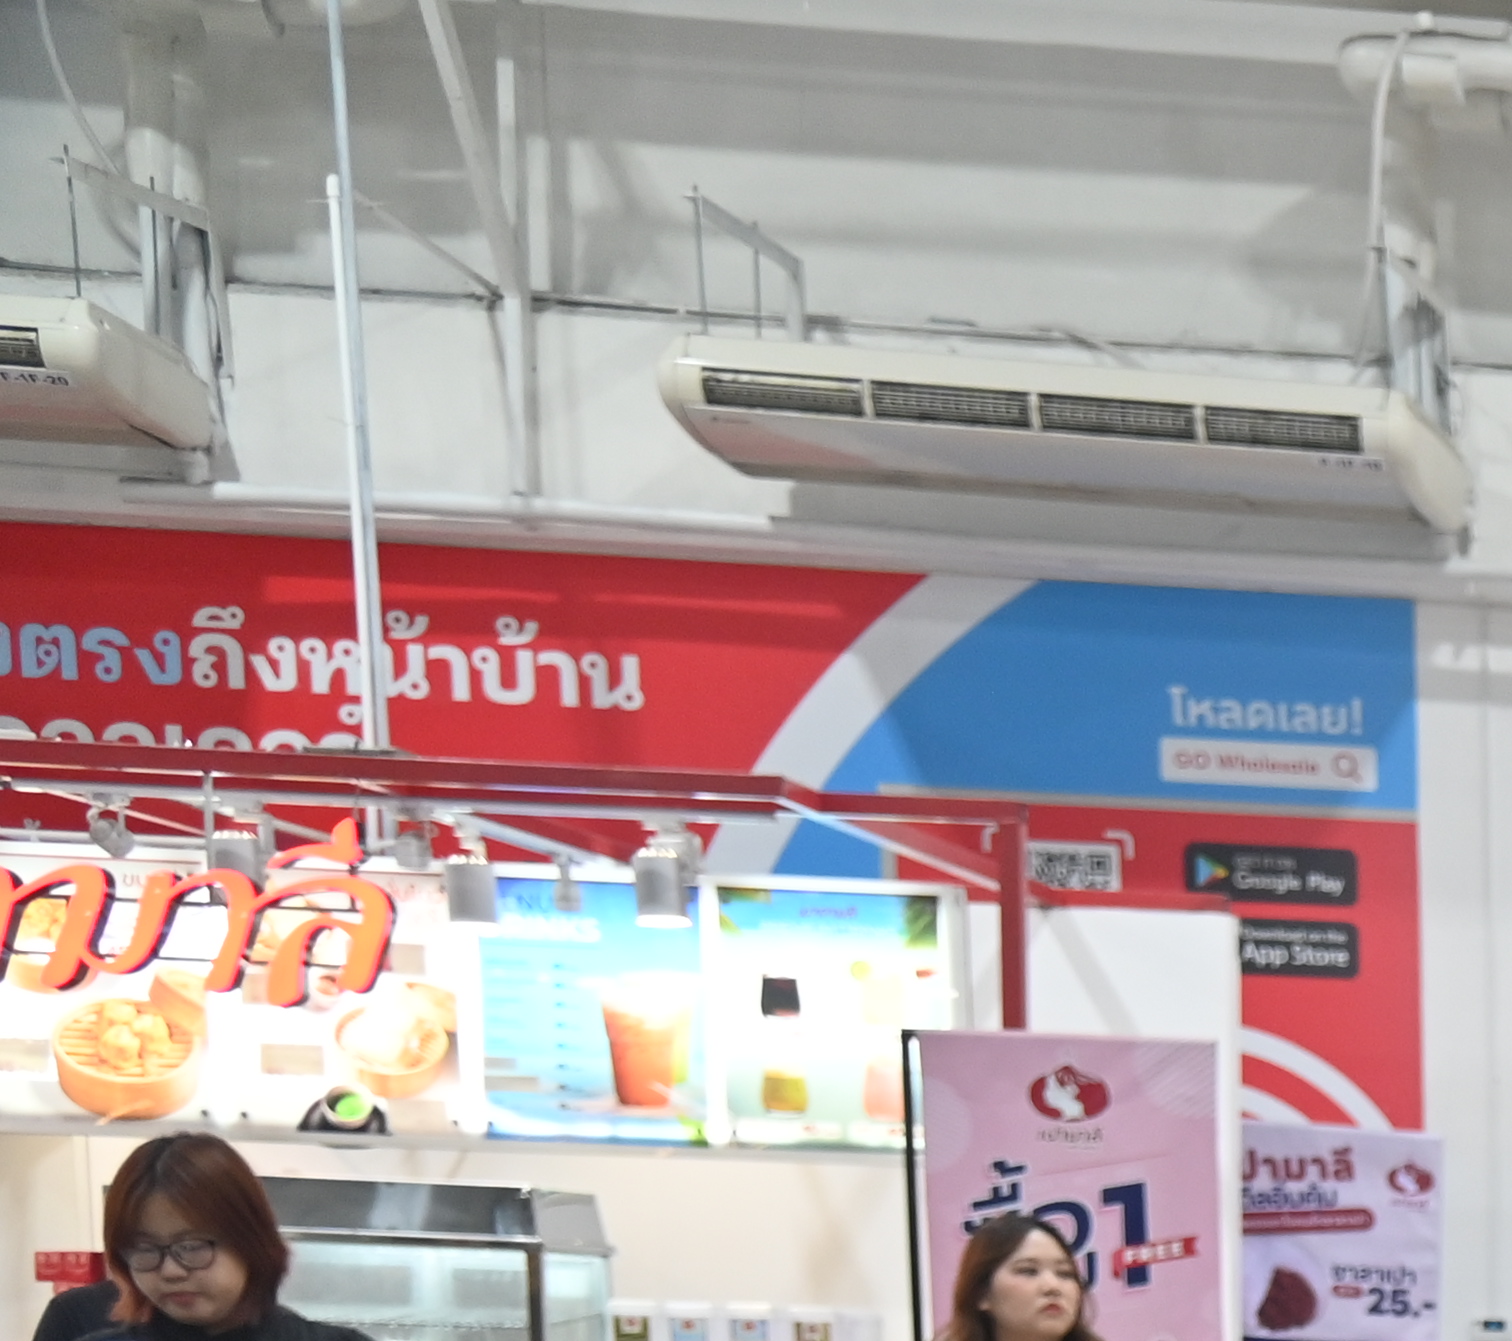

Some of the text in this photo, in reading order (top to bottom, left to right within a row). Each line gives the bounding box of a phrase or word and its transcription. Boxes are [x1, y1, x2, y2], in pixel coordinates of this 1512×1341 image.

[1167, 685, 1363, 736] โหลดเลย!
[1171, 749, 1211, 770] GO
[1232, 871, 1346, 898] Google Play
[1242, 941, 1351, 969] App Store
